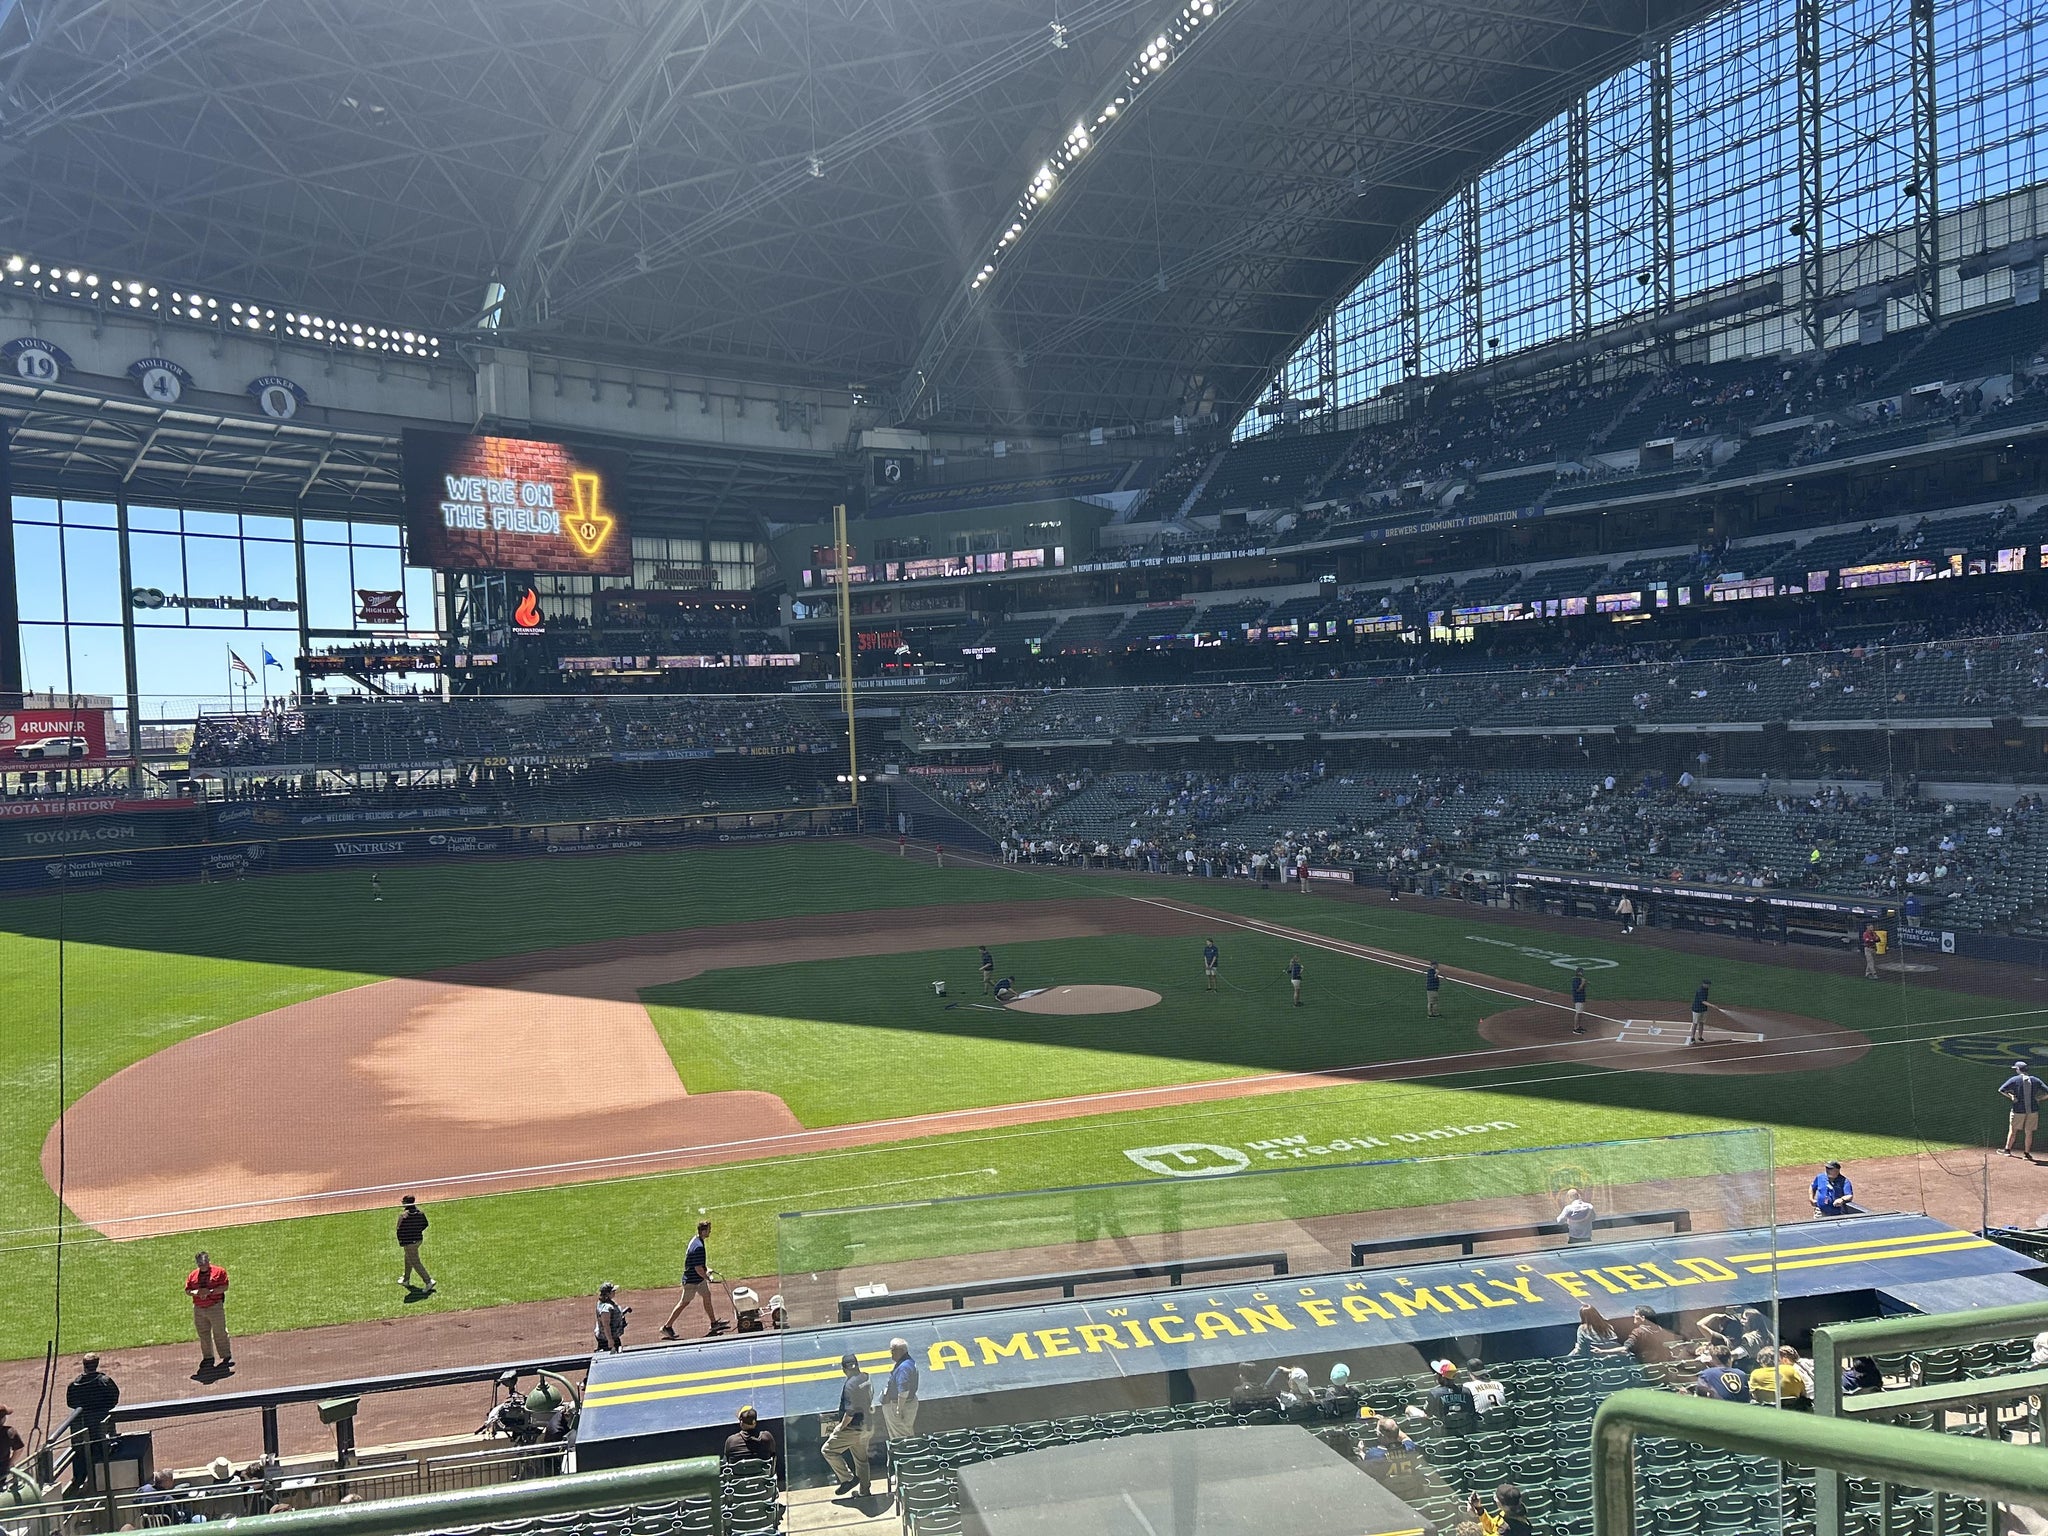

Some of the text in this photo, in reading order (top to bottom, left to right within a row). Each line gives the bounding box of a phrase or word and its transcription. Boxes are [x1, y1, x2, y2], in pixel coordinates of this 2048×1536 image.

[18, 339, 56, 353] YOUNT
[23, 355, 53, 378] 19
[137, 359, 183, 376] MOLITOR
[152, 375, 168, 397] 4
[258, 378, 294, 391] UECKER
[446, 475, 554, 507] WE'RE ON
[441, 503, 560, 534] THE FIELD!
[1385, 510, 1518, 538] BREWERS COMMUNITY FOUNDATION
[653, 565, 718, 581] Johnsonville
[169, 593, 299, 612] Aurora Health Care
[21, 721, 86, 733] 4RUNNER
[751, 745, 796, 756] NICOLET LAW
[56, 761, 88, 769] WISONSIN
[484, 755, 546, 766] 620 WTMJ
[0, 800, 117, 815] OYOTA TERRITORY
[422, 808, 450, 817] WELCOME
[326, 813, 355, 822] WELCOME
[23, 826, 135, 844] TOYOTA.COM
[448, 835, 477, 844] Aurora
[334, 841, 405, 855] WINTRUST
[447, 841, 497, 852] Health Care
[68, 859, 133, 870] Northwestern
[210, 853, 243, 863] Johnson
[216, 859, 249, 869] Contls
[69, 868, 103, 877] Mutual
[1920, 935, 1941, 943] CARRY
[1245, 1132, 1309, 1151] uw
[1263, 1118, 1521, 1161] credit union
[1106, 1263, 1533, 1318] WELCOME TO
[927, 1256, 1739, 1371] AMERICAN FAMILY FIELD
[1475, 1383, 1501, 1393] MERRILL
[1440, 1393, 1467, 1405] MERRILL
